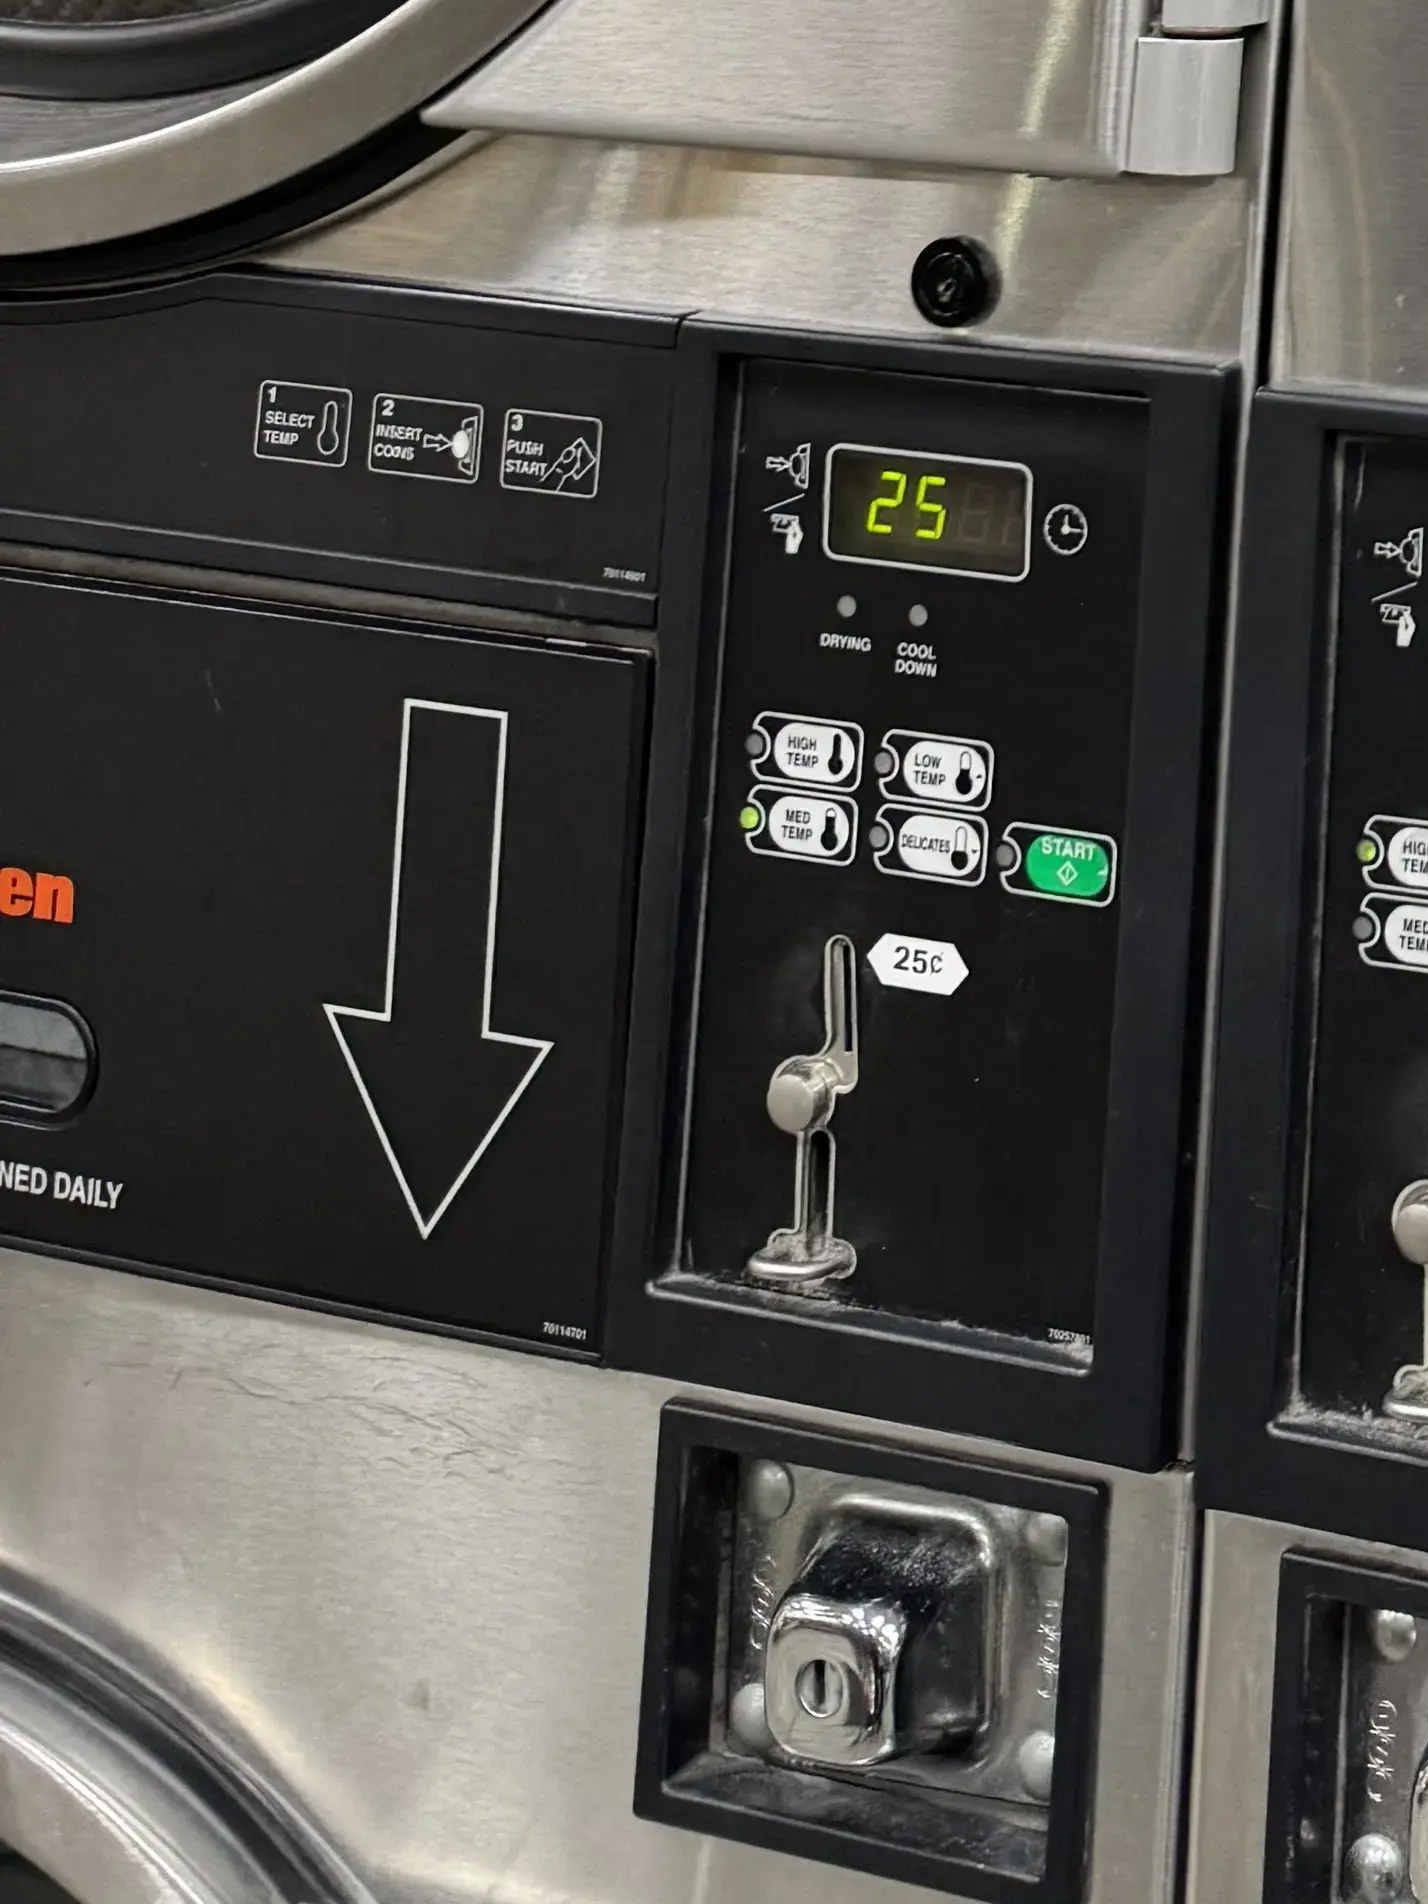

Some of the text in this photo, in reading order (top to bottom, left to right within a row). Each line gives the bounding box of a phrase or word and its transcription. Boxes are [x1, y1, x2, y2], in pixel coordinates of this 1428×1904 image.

[382, 400, 395, 417] 2
[264, 410, 315, 429] SELECT
[511, 414, 524, 431] 3
[263, 429, 299, 446] TEMP
[375, 424, 423, 443] INSERT
[374, 442, 415, 461] COINS
[506, 440, 544, 458] PUSH
[505, 458, 548, 478] START
[865, 470, 947, 540] 25
[819, 632, 872, 652] DRYING
[897, 641, 937, 660] COOL
[894, 658, 938, 678] DOWN
[787, 735, 817, 752] HIGH
[786, 752, 819, 769] TEMP
[914, 753, 942, 770] LOW
[913, 769, 947, 786] TEMP
[785, 808, 811, 825] MED
[781, 824, 813, 841] TEMP
[901, 833, 951, 853] DELICATES
[1041, 835, 1097, 863] START
[893, 944, 943, 975] 25¢
[53, 1171, 124, 1209] DAILY
